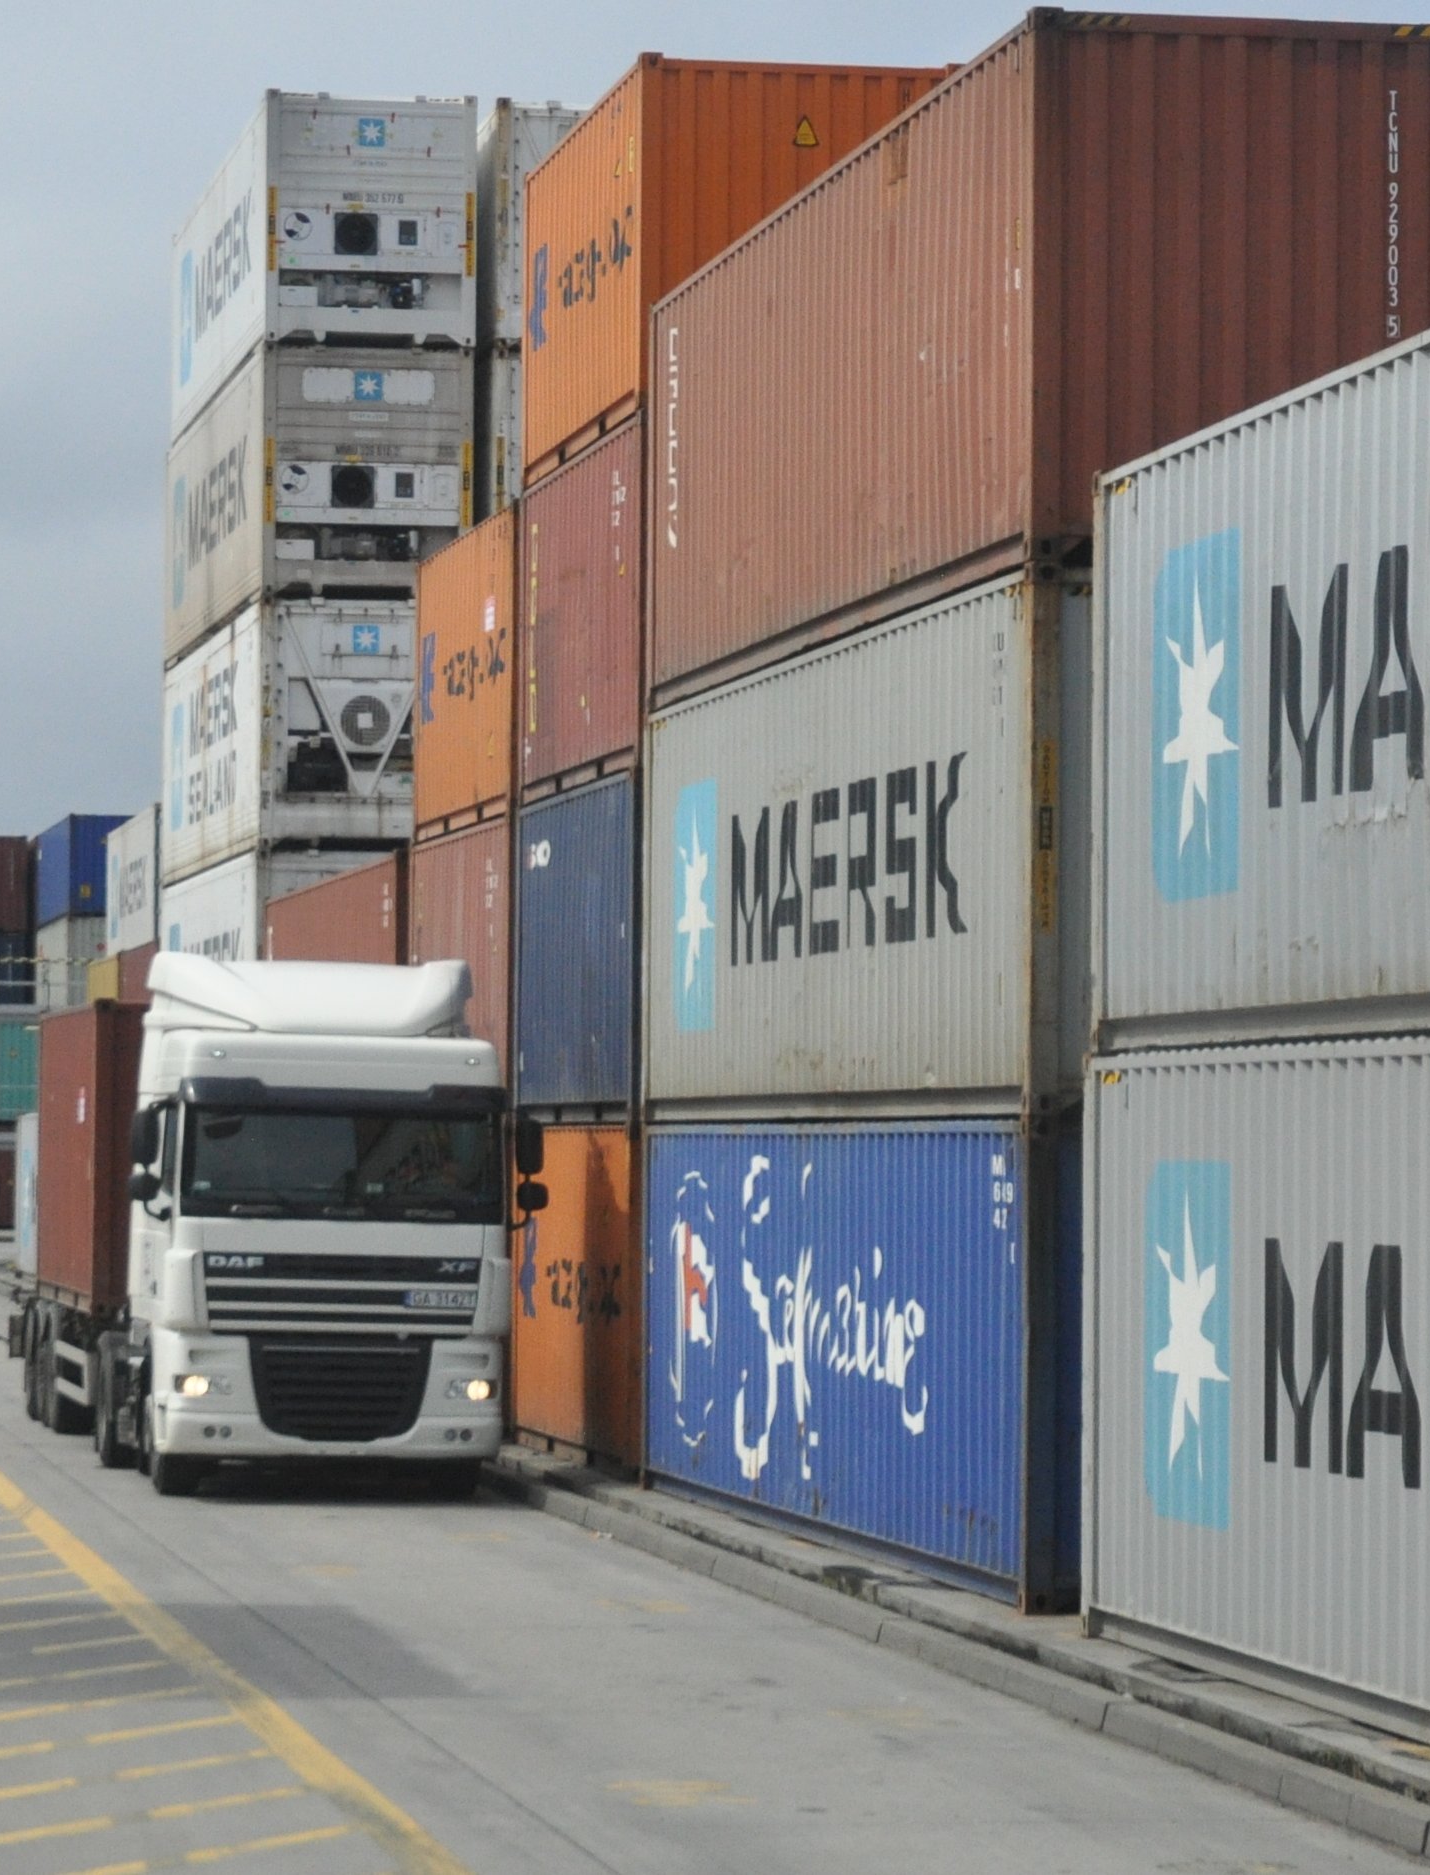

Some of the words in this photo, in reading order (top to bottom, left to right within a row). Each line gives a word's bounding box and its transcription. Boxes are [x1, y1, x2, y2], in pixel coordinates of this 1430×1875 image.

[1388, 90, 1399, 174] TCNU
[195, 186, 252, 343] MAERSK
[1388, 182, 1399, 307] 929003
[1387, 315, 1400, 337] 5
[188, 435, 247, 571] MAERSK
[731, 751, 968, 967] MAERSK
[208, 1255, 264, 1268] DAF
